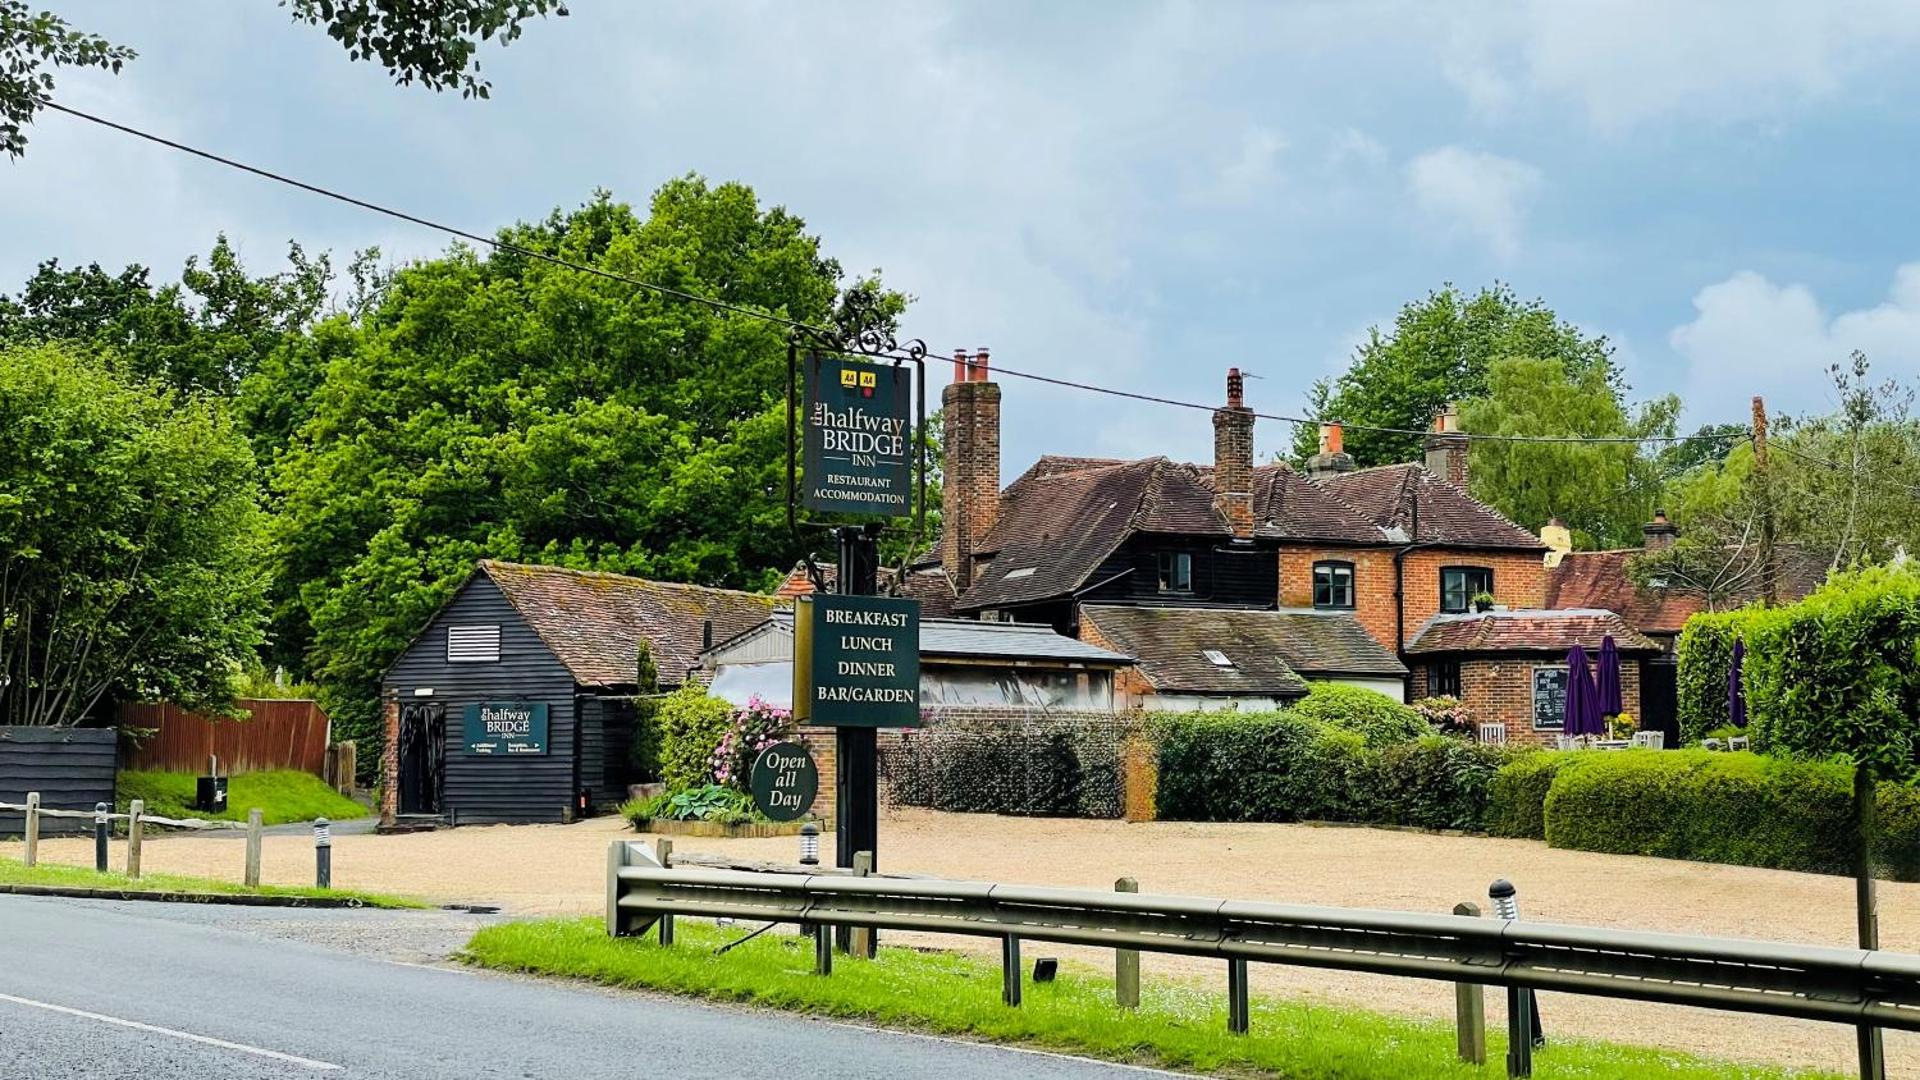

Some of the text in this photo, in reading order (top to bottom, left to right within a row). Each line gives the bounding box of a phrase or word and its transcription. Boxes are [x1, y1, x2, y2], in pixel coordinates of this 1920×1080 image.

[810, 402, 905, 437] the halfway
[823, 429, 904, 456] BRIDGE
[852, 454, 876, 468] INN
[827, 474, 892, 489] RESTAURANT
[813, 488, 905, 504] ACCOMMODATION
[826, 609, 909, 627] BREAKFAST
[841, 636, 892, 651] LUNCH
[838, 661, 896, 677] DINNER
[817, 686, 915, 703] BAR/GARDEN
[487, 708, 531, 721] halfway
[486, 721, 531, 733] BRIDGE
[766, 752, 806, 774] Open
[775, 771, 797, 788] all
[769, 790, 802, 811] Day
